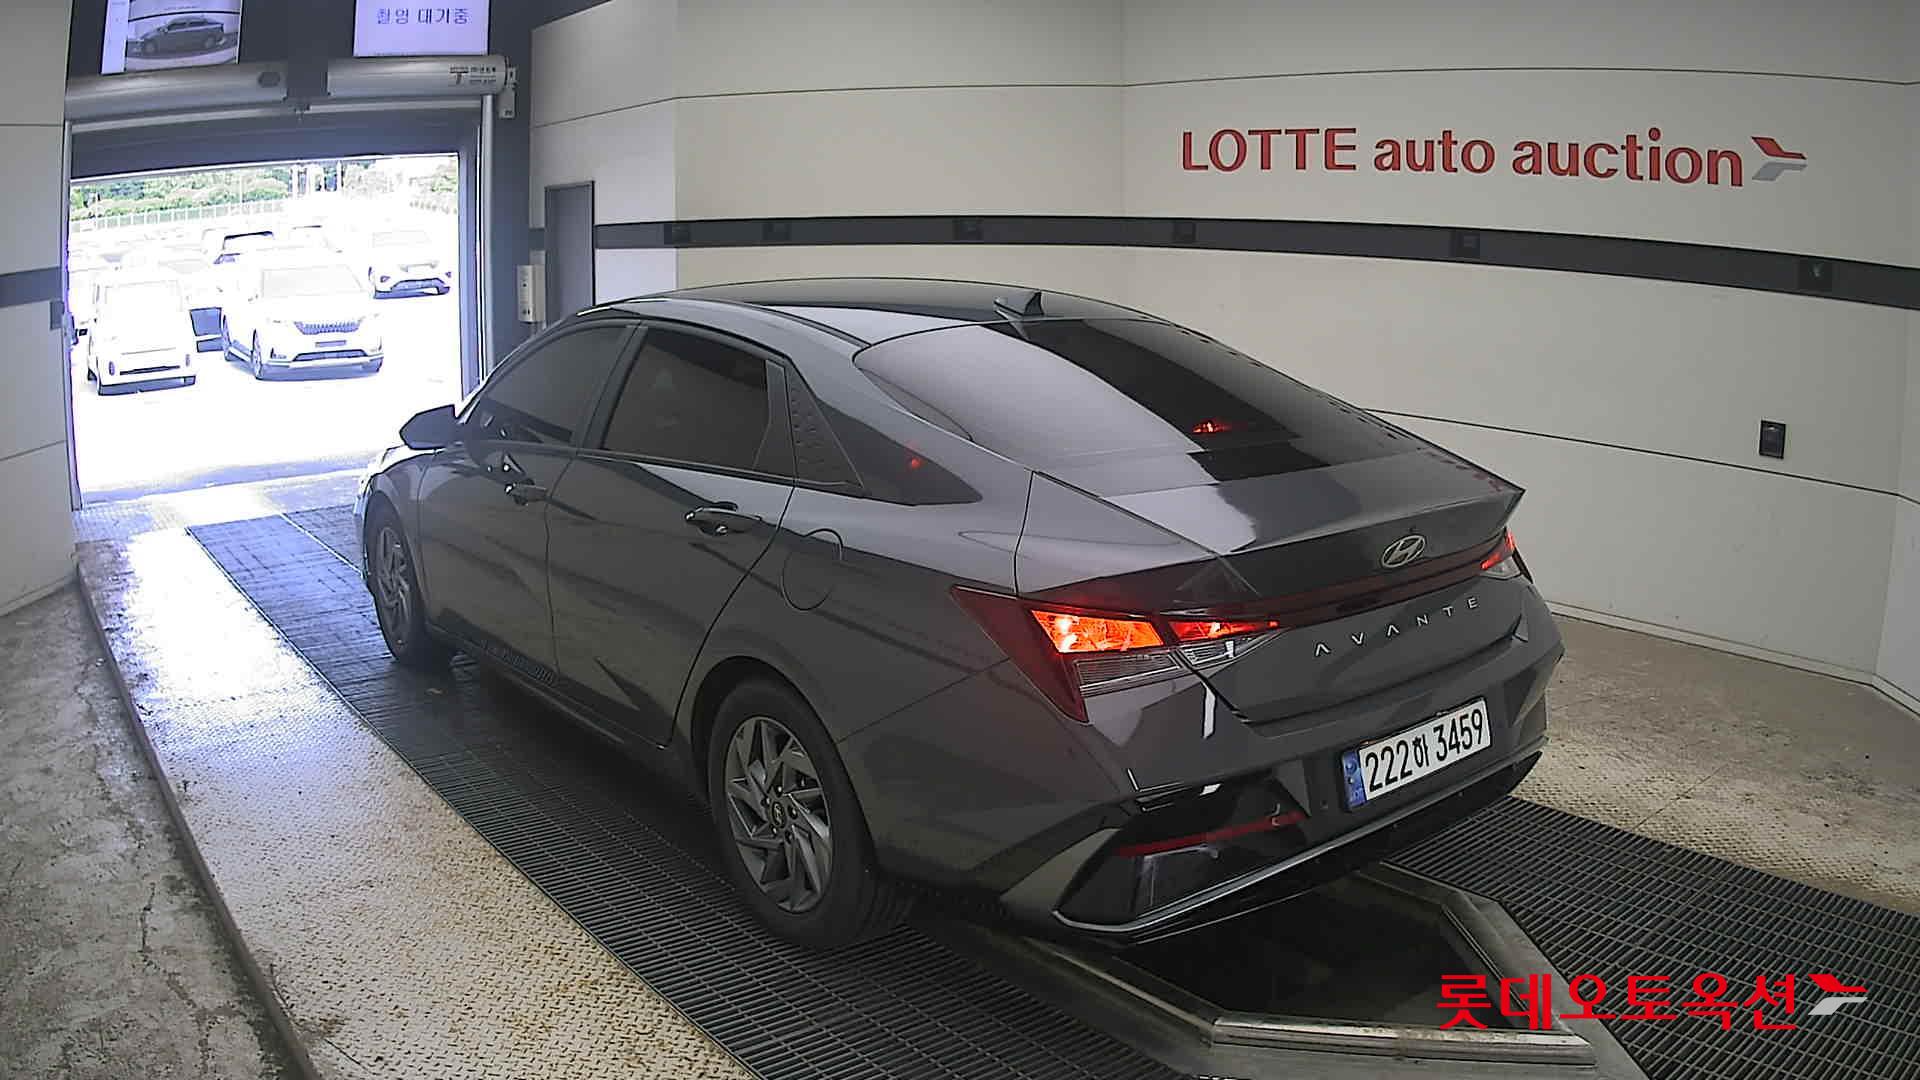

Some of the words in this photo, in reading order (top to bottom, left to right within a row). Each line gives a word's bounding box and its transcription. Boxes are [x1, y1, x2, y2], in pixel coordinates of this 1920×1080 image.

[417, 8, 472, 25] 대기중
[1182, 127, 1358, 172] LOTTE
[1373, 129, 1496, 174] auto
[1512, 127, 1744, 188] auction
[1314, 596, 1480, 657] AVANTE
[1365, 733, 1430, 793] 222하
[1433, 708, 1483, 762] 3459
